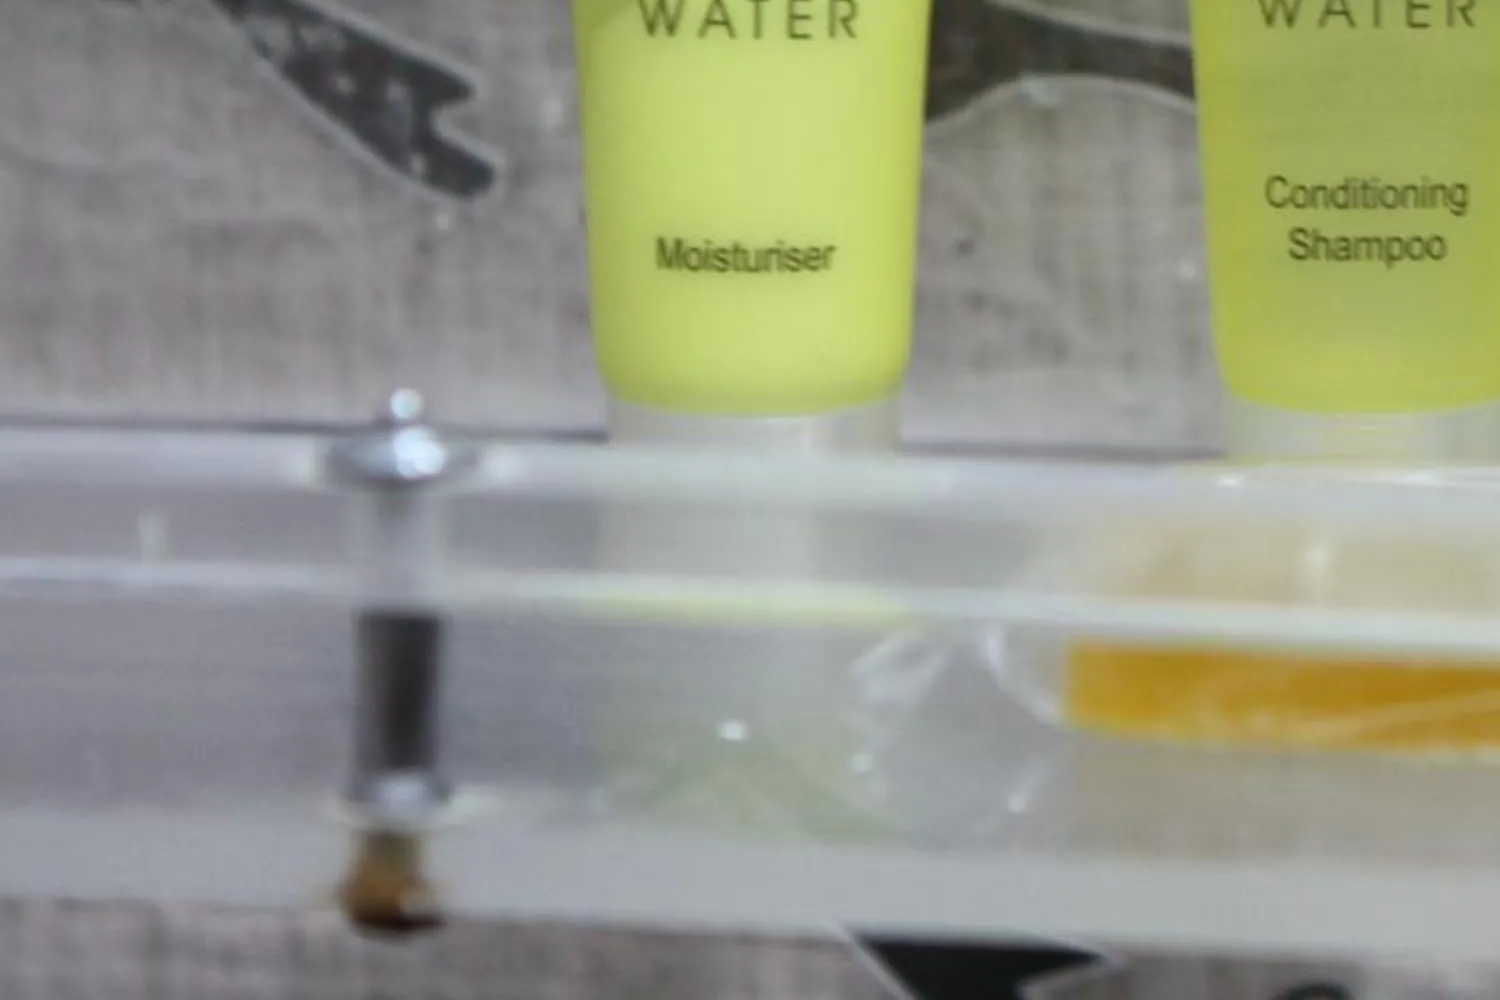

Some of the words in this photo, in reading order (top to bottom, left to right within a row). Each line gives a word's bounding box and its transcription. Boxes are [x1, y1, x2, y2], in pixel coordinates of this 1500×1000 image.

[1264, 174, 1470, 218] Conditioning
[655, 235, 838, 274] Moisturiser
[1288, 226, 1447, 269] Shampoo
